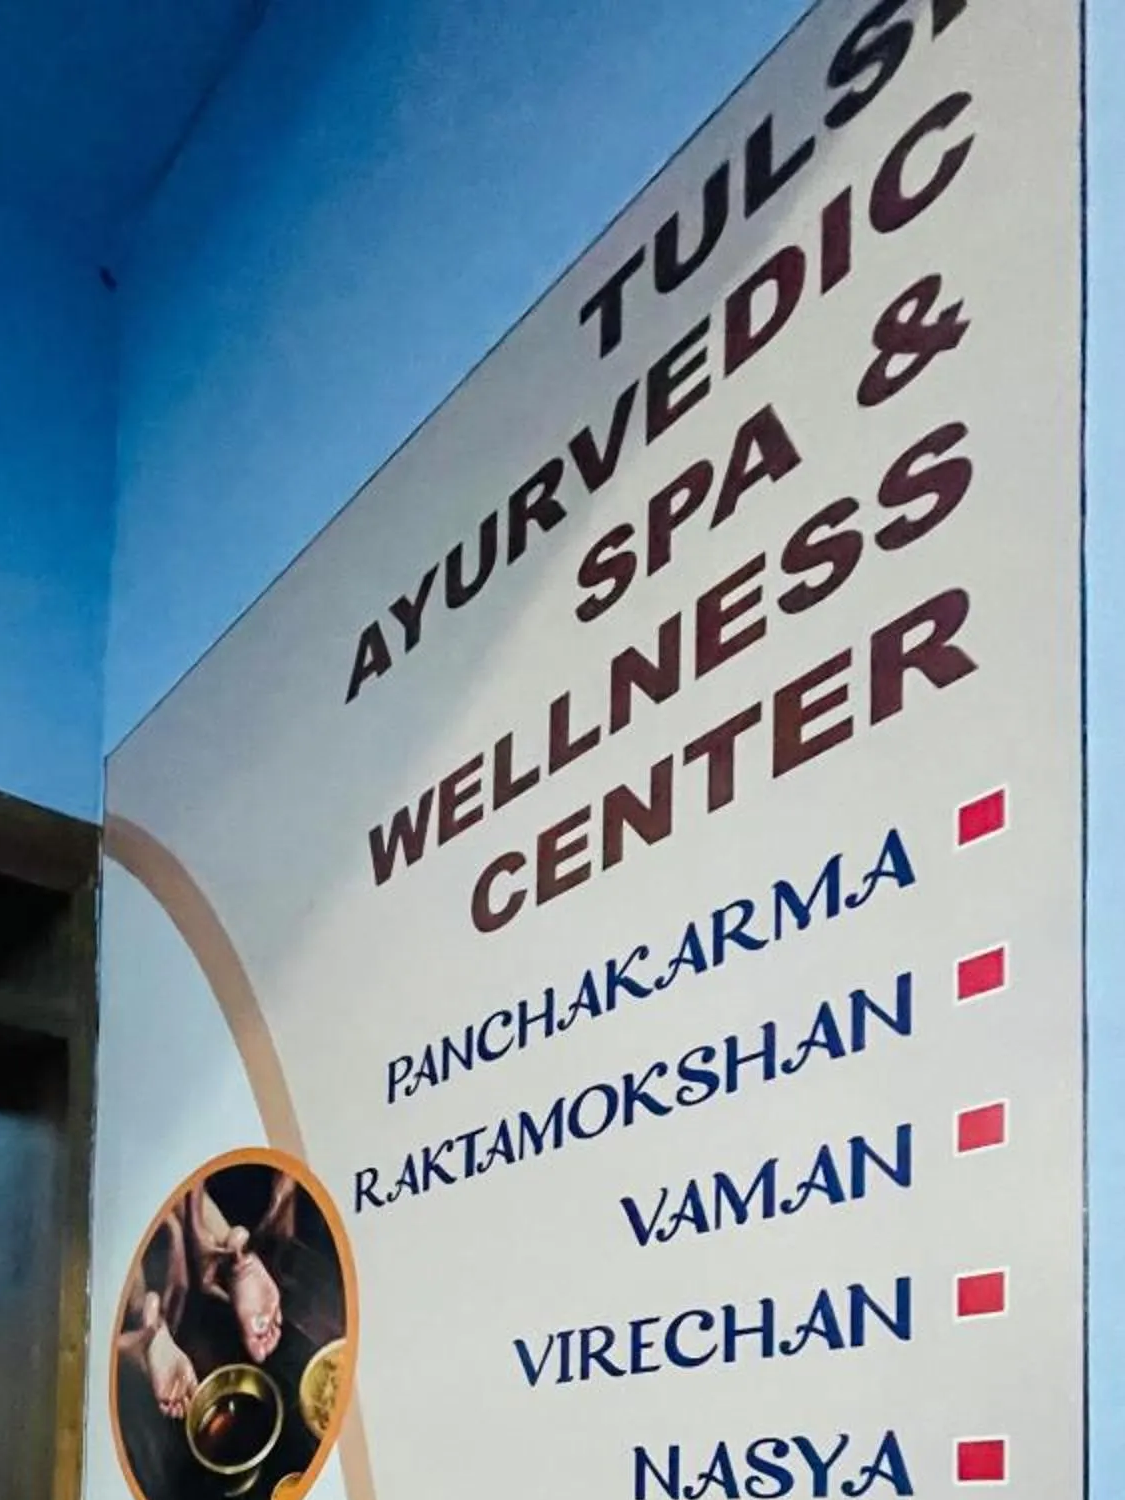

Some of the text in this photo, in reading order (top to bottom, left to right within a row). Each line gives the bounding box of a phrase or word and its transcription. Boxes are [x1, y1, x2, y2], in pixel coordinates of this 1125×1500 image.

[345, 91, 975, 704] AYURVEDIC
[576, 275, 970, 622] SPA &
[369, 422, 973, 886] WELLNESS
[471, 589, 978, 932] CENTER
[353, 971, 912, 1212] RAKTAMOKSHAN
[386, 828, 916, 1104] PANCHAKARMA
[513, 1276, 911, 1386] VIRECHAN
[619, 1123, 912, 1247] VAMAN
